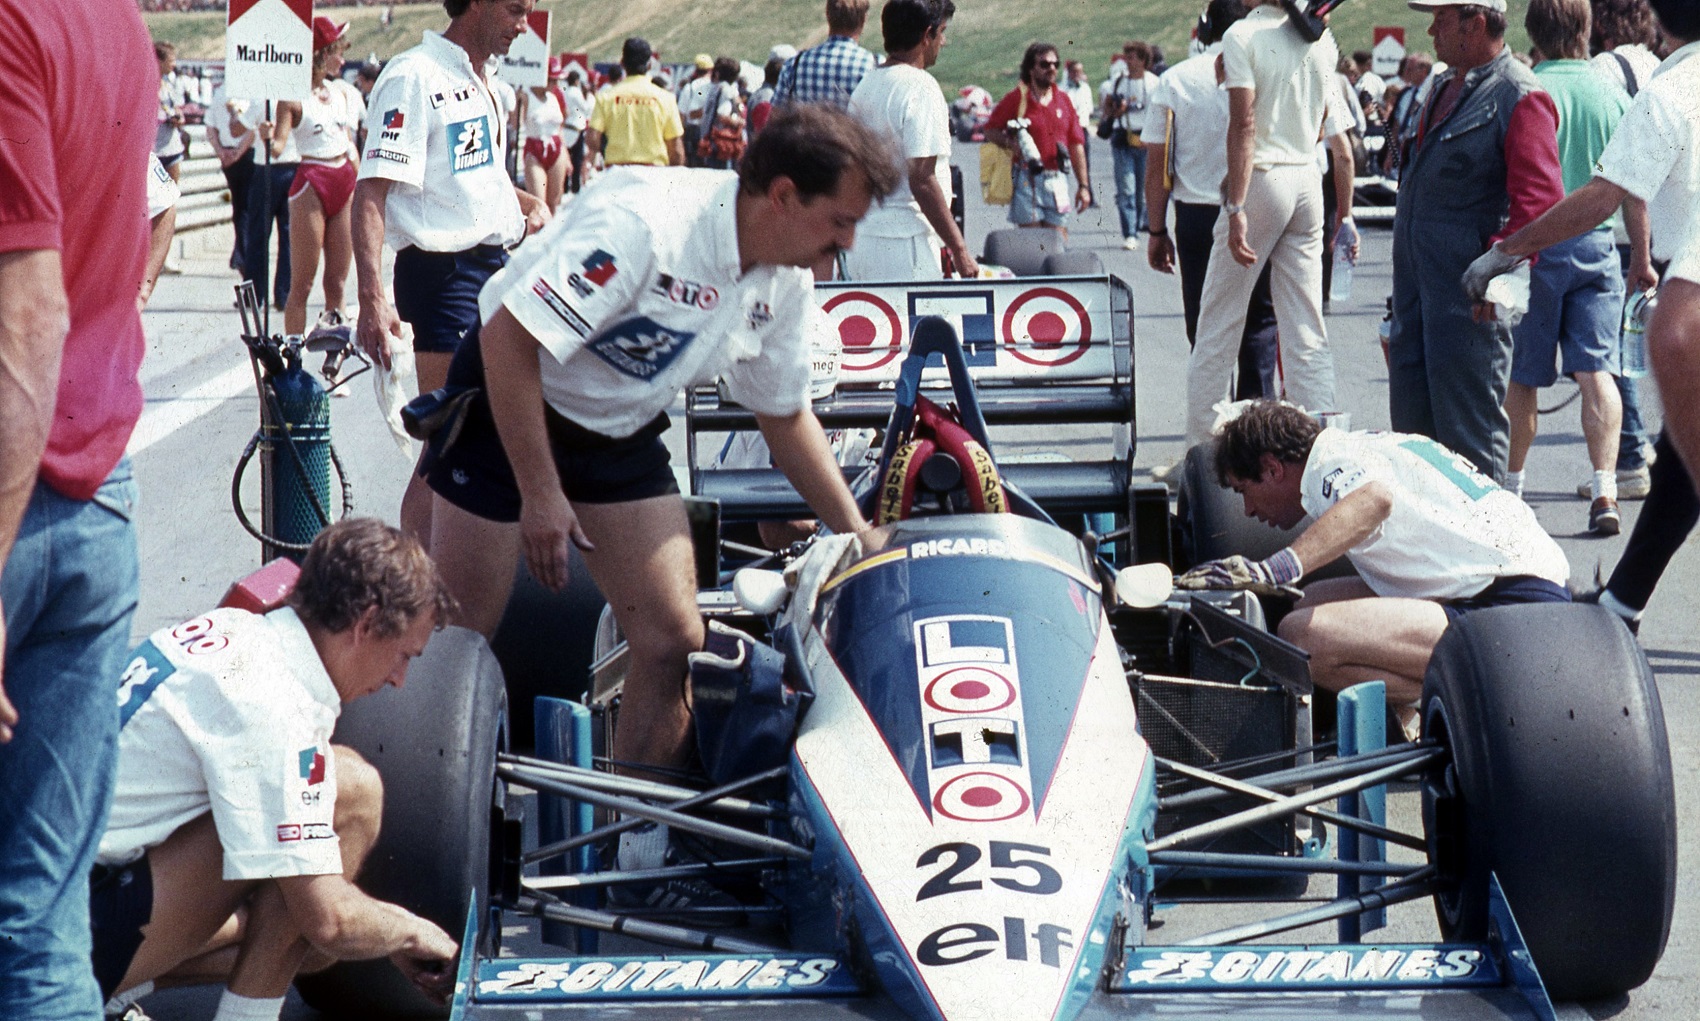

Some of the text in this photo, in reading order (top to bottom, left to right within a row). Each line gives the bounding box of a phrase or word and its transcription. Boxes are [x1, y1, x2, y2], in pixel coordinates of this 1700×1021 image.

[237, 44, 303, 65] Marlboro
[821, 286, 1092, 371] OTO
[974, 450, 1001, 513] Sabel
[915, 840, 1064, 902] 25
[915, 915, 1074, 967] elf
[1210, 949, 1484, 984] GITANES
[560, 957, 841, 994] GITANES
